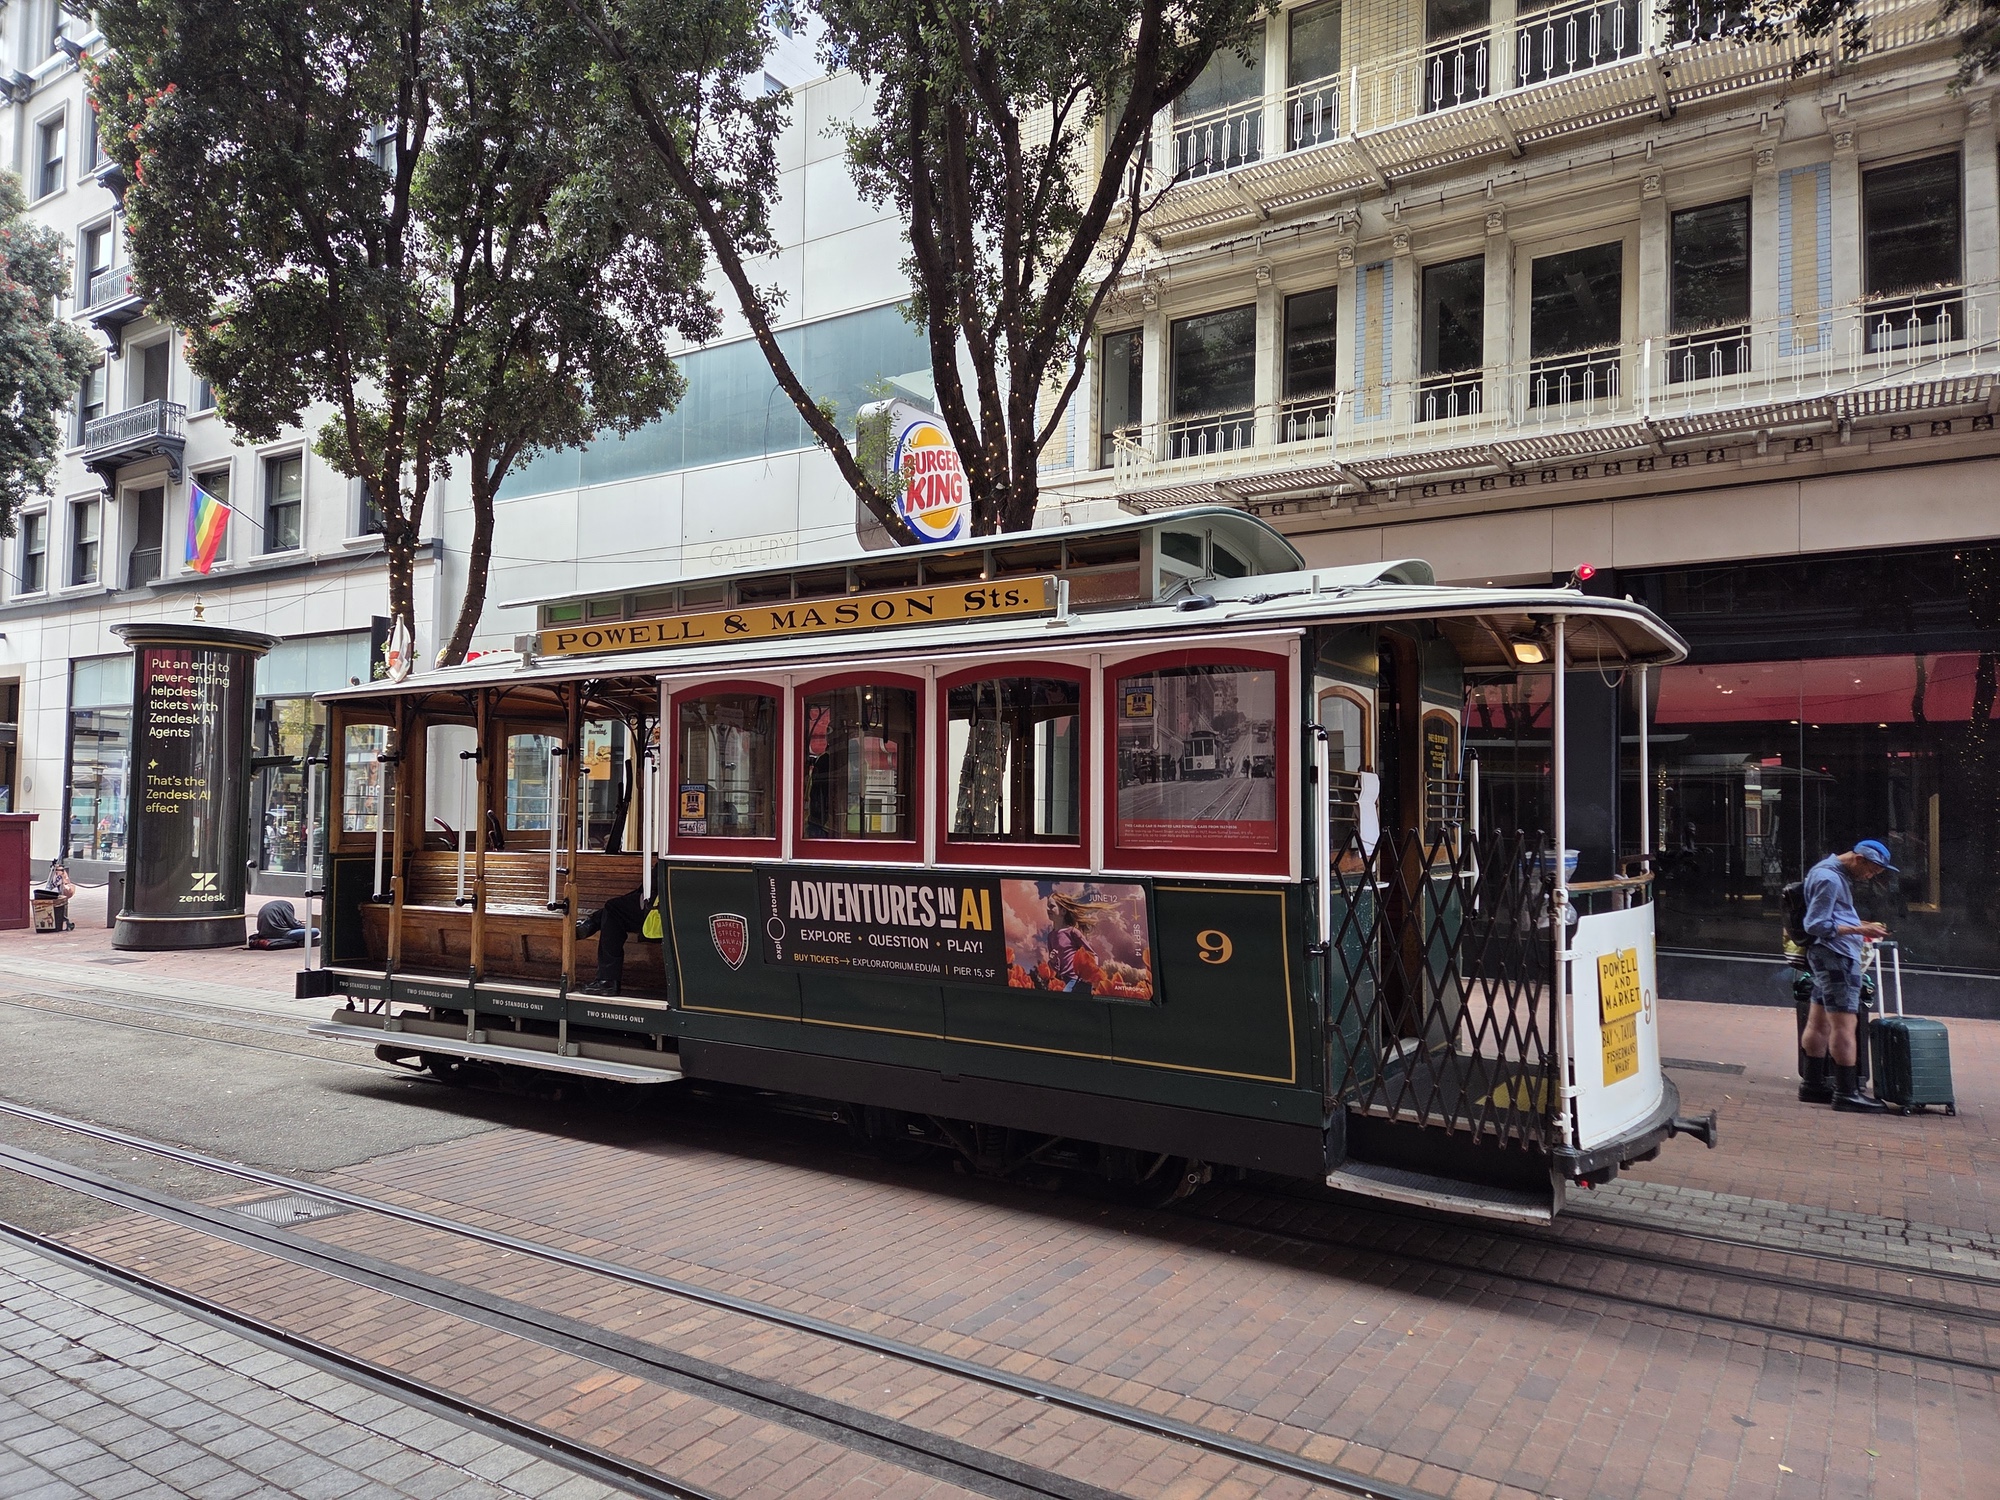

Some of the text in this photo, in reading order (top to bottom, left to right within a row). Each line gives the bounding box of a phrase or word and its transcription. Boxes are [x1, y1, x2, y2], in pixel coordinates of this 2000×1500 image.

[903, 450, 960, 478] BURGER
[906, 472, 963, 513] KING
[710, 537, 791, 566] GALLERY
[556, 588, 1029, 650] POWELL & MASON Sts.
[152, 658, 230, 672] Put an end to
[151, 674, 230, 688] never-ending
[151, 685, 205, 698] helpdesk
[150, 699, 218, 712] tickets with
[149, 713, 200, 724] Zendesk
[149, 726, 190, 739] Agents
[184, 776, 206, 787] the
[146, 789, 211, 800] Zendesk AI
[146, 803, 179, 813] effect
[179, 892, 226, 903] zendesk
[1089, 894, 1118, 903] JUNE 12
[789, 880, 992, 931] ADVENTURES IN AI
[718, 930, 741, 938] STREET
[1133, 923, 1142, 957] SEPT 14
[800, 929, 983, 954] EXPLORE QUESTION PLAY!
[1196, 929, 1233, 965] 9
[793, 953, 996, 978] BUY TICKETS EXPLORATORIUM.EDU/AI PIER 15, SF
[1603, 957, 1638, 980] POWELL
[1614, 975, 1631, 990] AND
[418, 990, 440, 998] STANDEES
[1605, 987, 1640, 1011] MARKET
[492, 998, 544, 1011] TWO STANDEES ONLY
[1643, 988, 1651, 1025] 9
[587, 1010, 645, 1023] TWO STANDEES ONLY
[1602, 1029, 1613, 1048] BAY
